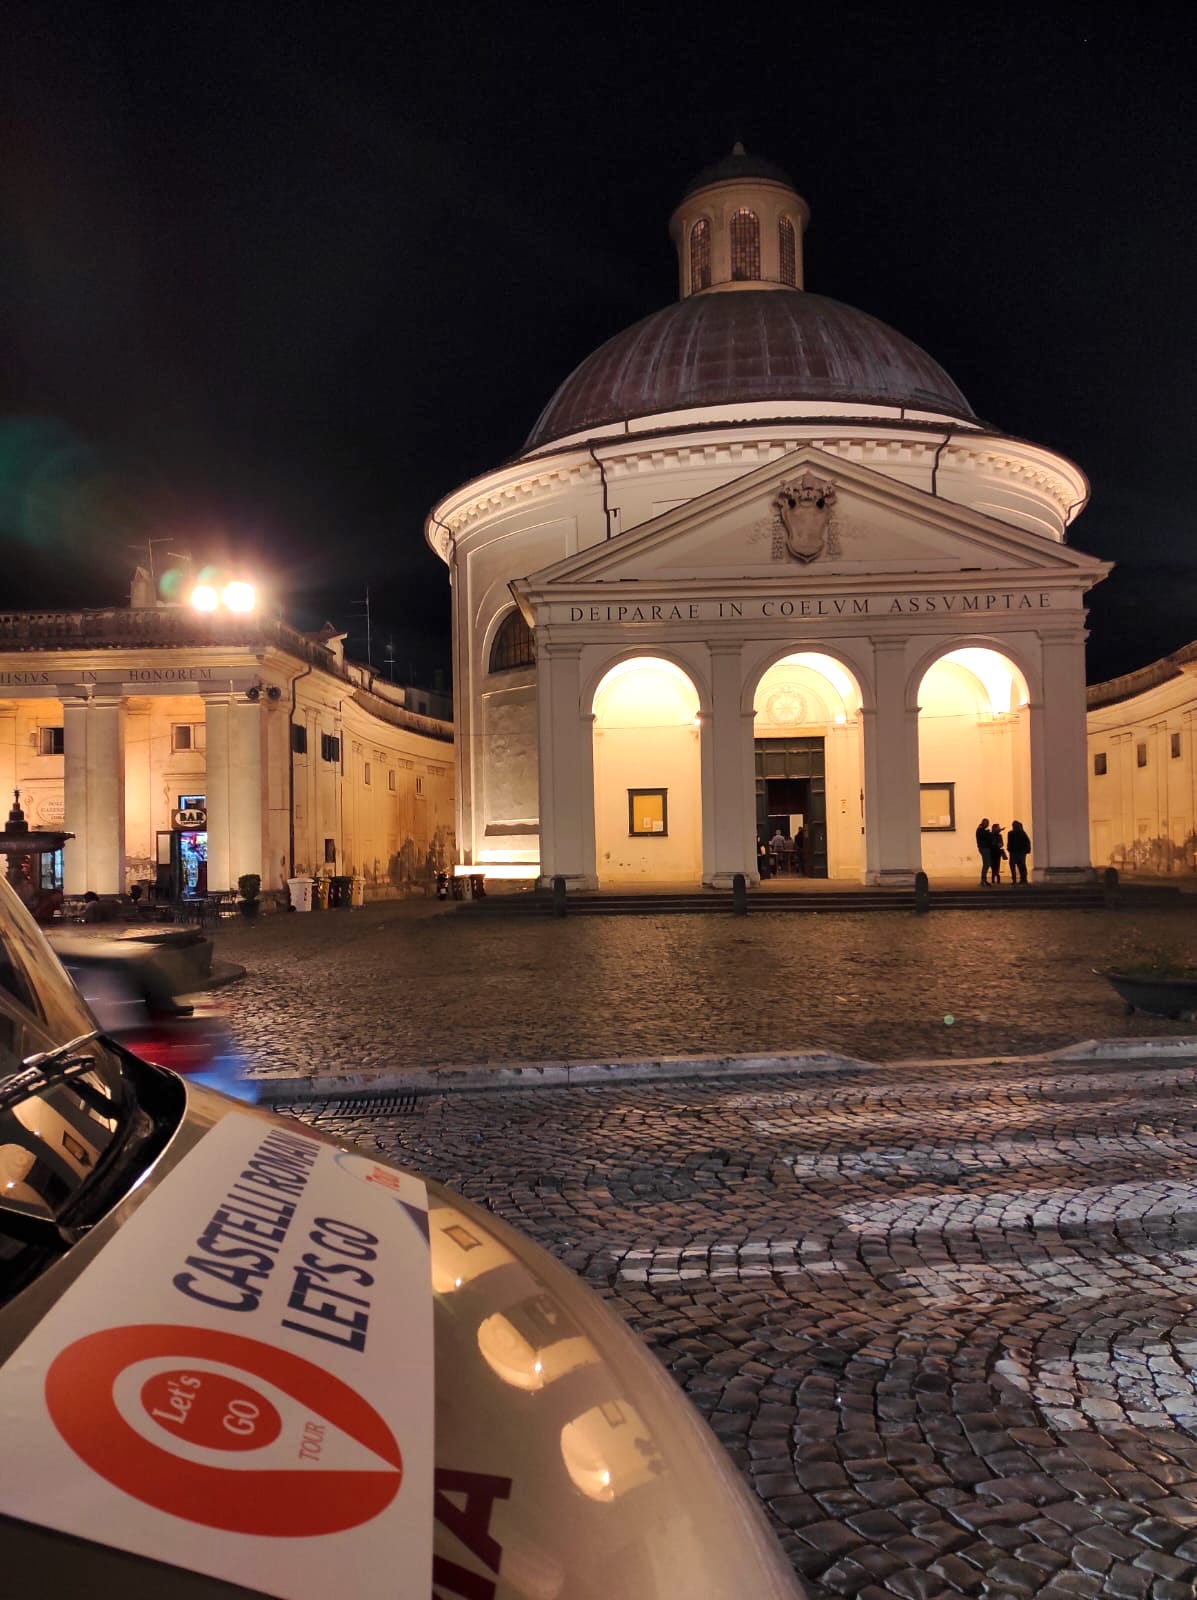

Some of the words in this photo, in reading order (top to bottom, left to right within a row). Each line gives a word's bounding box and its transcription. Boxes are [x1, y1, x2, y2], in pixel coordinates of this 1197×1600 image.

[570, 603, 700, 622] DEIPARAE
[718, 602, 744, 617] IN
[762, 599, 869, 617] COELVM
[889, 592, 1051, 613] ASSVMPTAE
[81, 671, 97, 683] IN
[129, 668, 212, 681] HONOREM
[180, 812, 205, 821] BAR
[172, 1183, 297, 1312] CASTELLI
[240, 1129, 321, 1197] ROMANI
[309, 1217, 379, 1261] GO
[281, 1253, 375, 1353] LET'S
[152, 1375, 201, 1424] Let's
[223, 1400, 260, 1435] GO
[299, 1421, 326, 1461] TOUR
